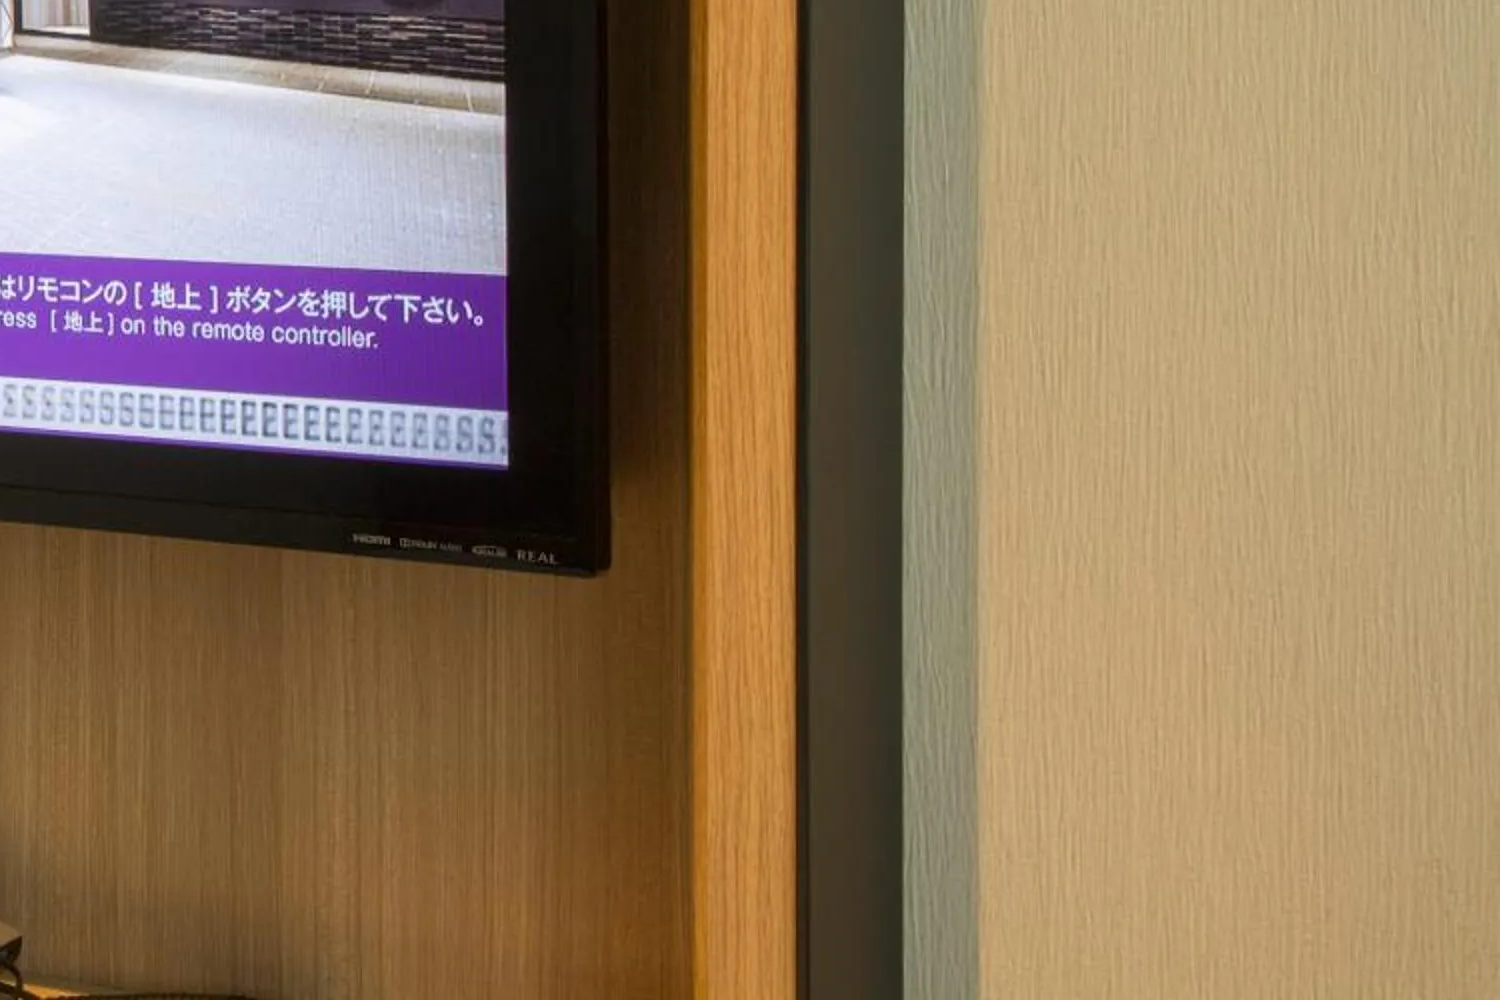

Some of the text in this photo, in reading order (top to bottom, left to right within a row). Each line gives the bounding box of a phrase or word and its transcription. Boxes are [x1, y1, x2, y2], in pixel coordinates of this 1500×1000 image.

[120, 315, 146, 336] on
[152, 315, 185, 338] the
[192, 319, 265, 344] remote
[271, 324, 379, 350] controller.
[516, 549, 558, 565] REAL
